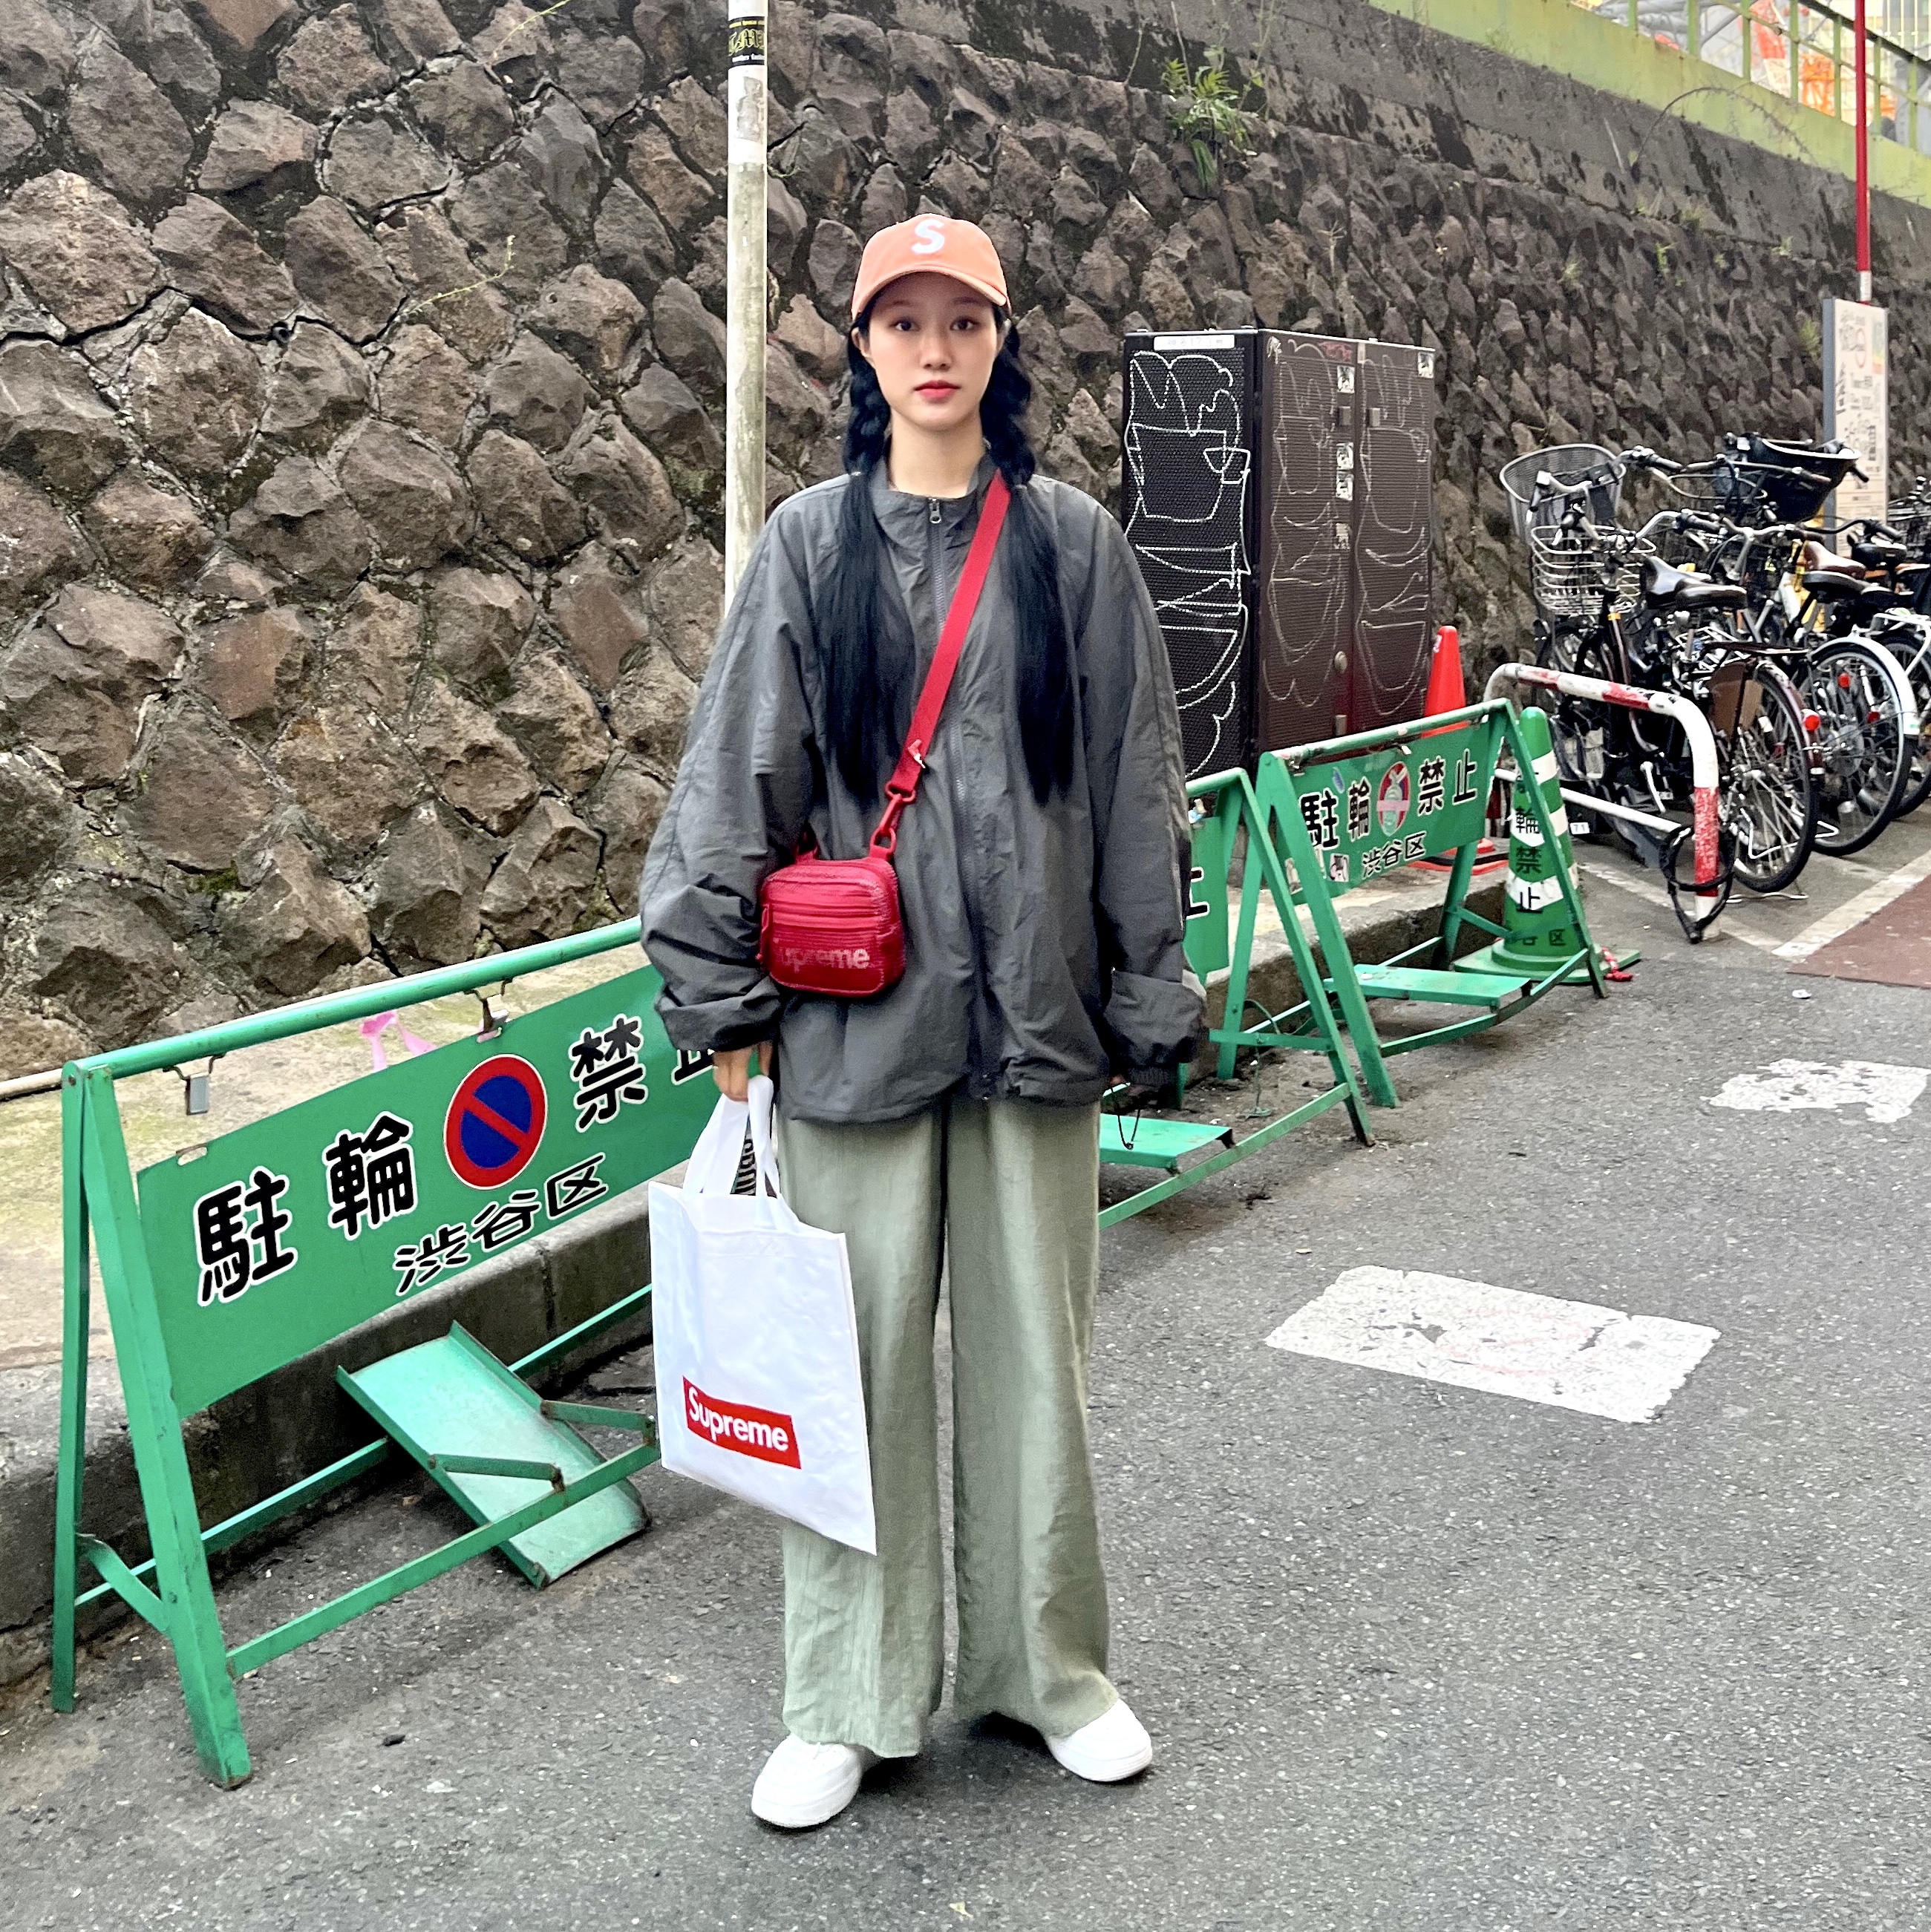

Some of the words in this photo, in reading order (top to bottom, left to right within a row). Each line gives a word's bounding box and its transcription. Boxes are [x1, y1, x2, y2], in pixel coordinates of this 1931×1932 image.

[912, 219, 945, 254] S
[1299, 776, 1372, 851] 駐輪
[1417, 747, 1477, 817] 禁止
[1361, 830, 1427, 880] 渋谷区
[194, 1111, 418, 1306] 駐輪
[393, 1153, 609, 1295] 渋谷区
[688, 1386, 789, 1452] Supreme
